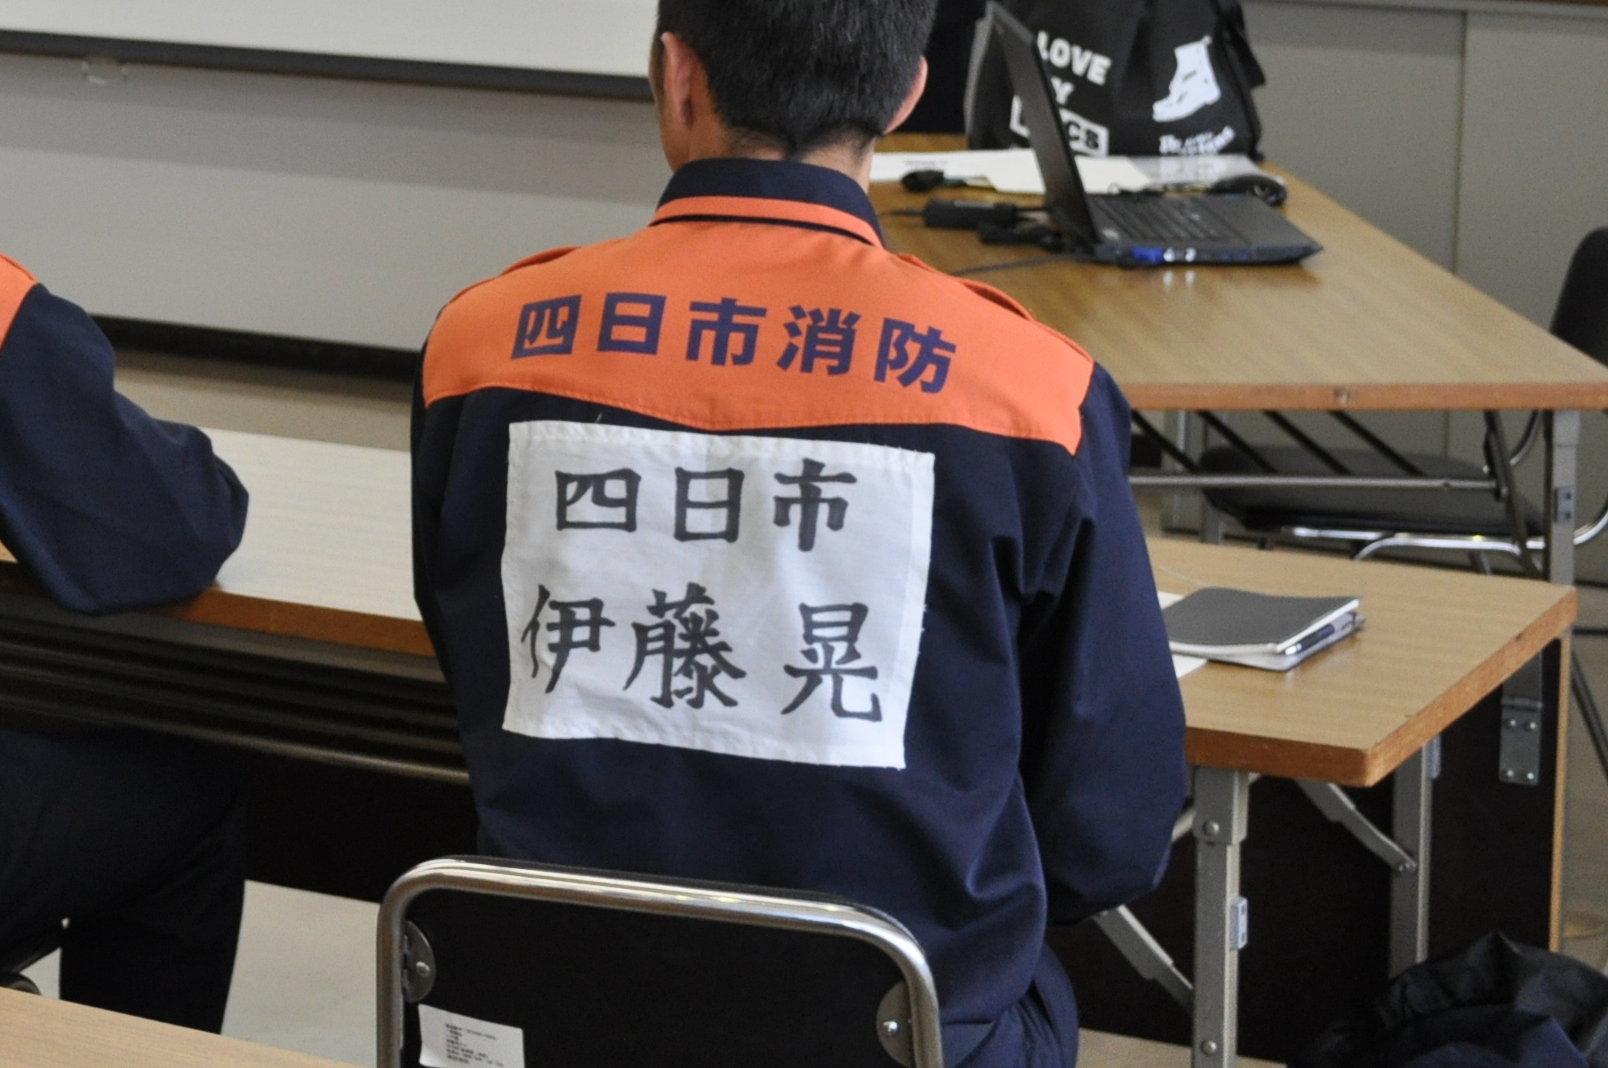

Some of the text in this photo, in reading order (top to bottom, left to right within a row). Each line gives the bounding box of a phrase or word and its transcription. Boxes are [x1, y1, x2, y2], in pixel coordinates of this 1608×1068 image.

[1037, 30, 1112, 85] LOVE
[509, 291, 957, 394] 四日市消防
[554, 457, 858, 553] 四日市
[520, 583, 747, 710] 伊藤
